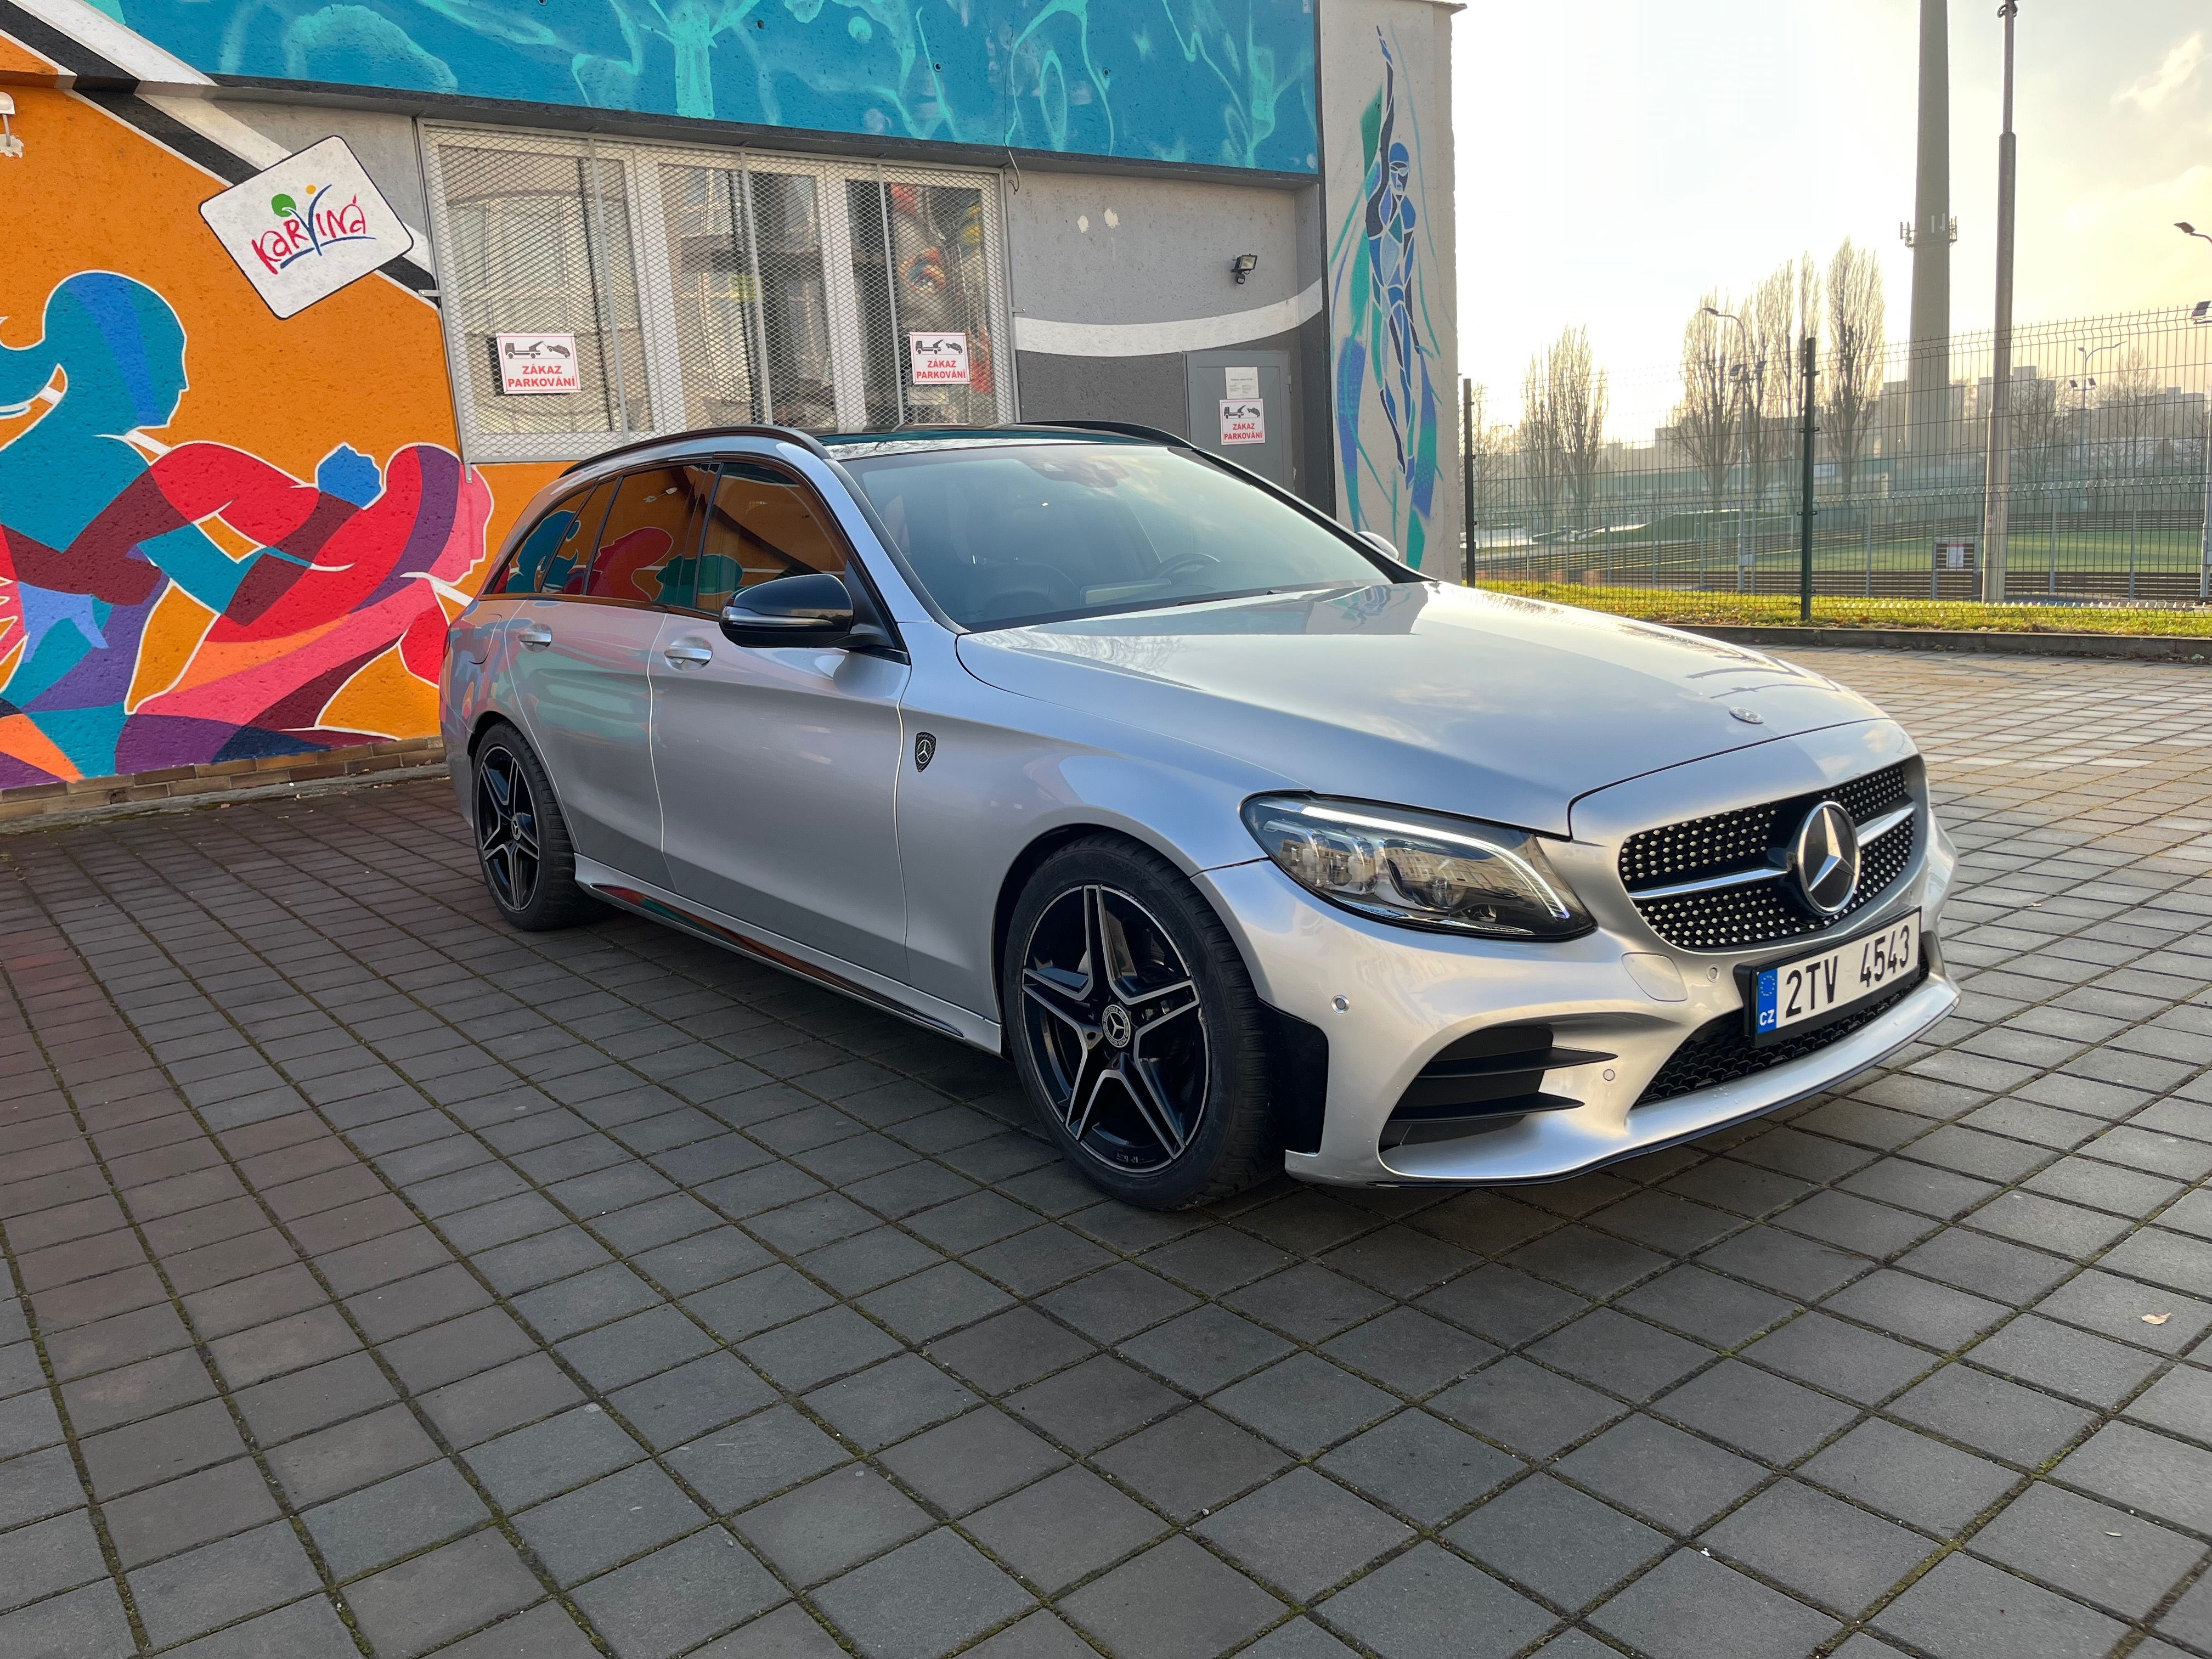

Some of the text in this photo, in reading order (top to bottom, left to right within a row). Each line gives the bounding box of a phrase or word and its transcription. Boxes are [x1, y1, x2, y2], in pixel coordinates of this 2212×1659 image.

[927, 359, 957, 368] ZÁKAZ
[522, 364, 562, 374] ZÁKAZ
[916, 370, 966, 379] PARKOVÁNÍ
[507, 376, 575, 387] PARKOVÁNÍ
[1232, 422, 1256, 431] ZÁKAZ
[1224, 431, 1262, 440] PARKOVÁNÍ
[1785, 924, 1910, 1018] 2TV 4543
[1759, 1009, 1775, 1026] CZ
